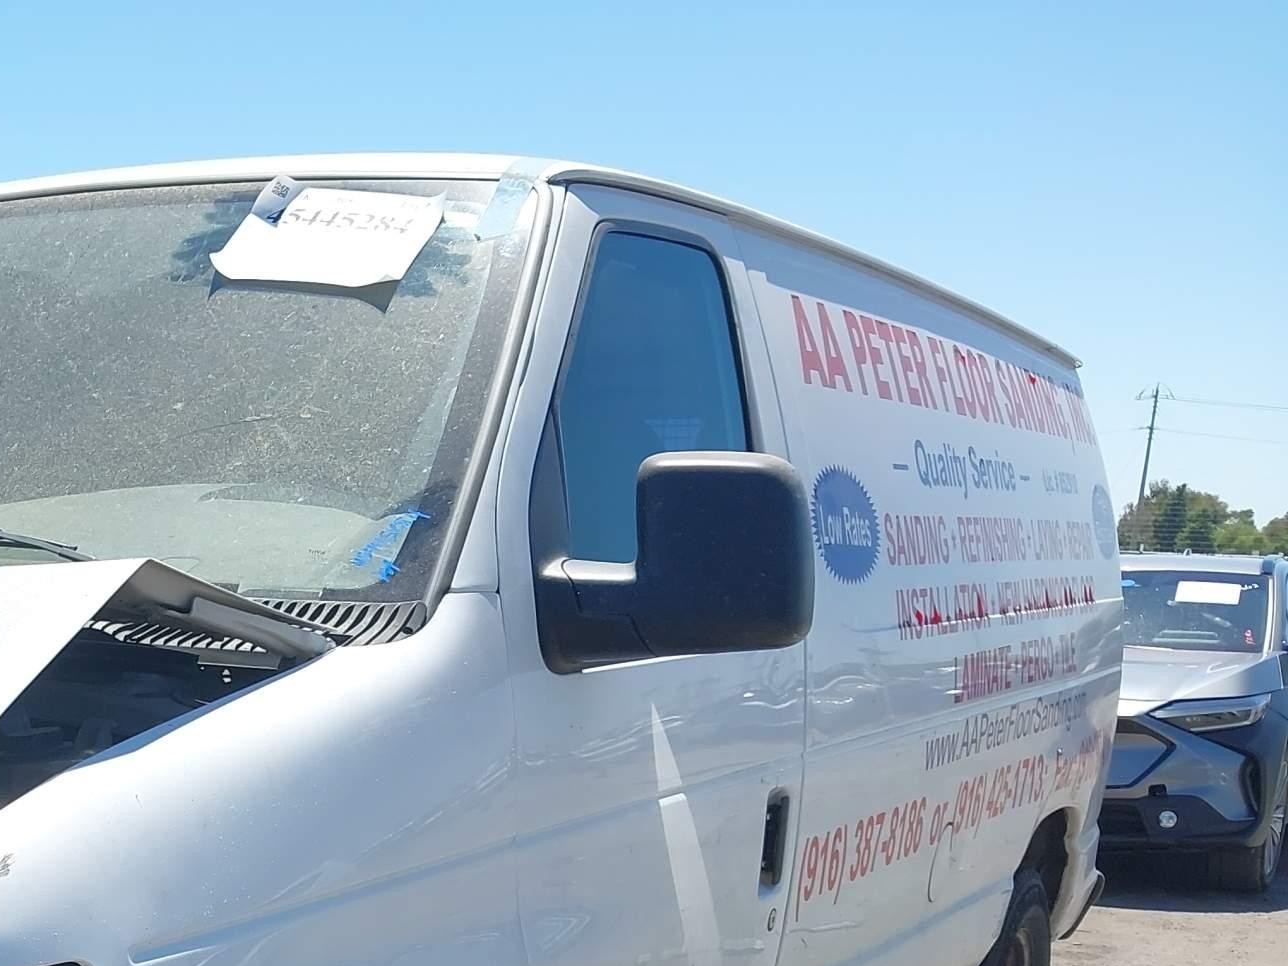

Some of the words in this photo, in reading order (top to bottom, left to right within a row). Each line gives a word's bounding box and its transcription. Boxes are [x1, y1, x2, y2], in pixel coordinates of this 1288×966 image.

[791, 294, 853, 392] AA
[842, 309, 938, 410] PETER
[927, 336, 1005, 424] FLOOR
[914, 439, 969, 500] Quality
[968, 446, 1017, 491] Service
[818, 503, 843, 546] Low
[842, 506, 873, 547] Rates
[884, 512, 950, 566] SANDING
[957, 516, 1026, 563] REFINISHING
[896, 581, 991, 641] INSTALLATION
[954, 644, 1012, 703] LAMINATE
[1021, 637, 1054, 684] PERGO
[796, 824, 848, 922] (916)
[850, 796, 927, 881] 387-8186
[930, 801, 950, 846] or
[951, 771, 988, 840] (916)
